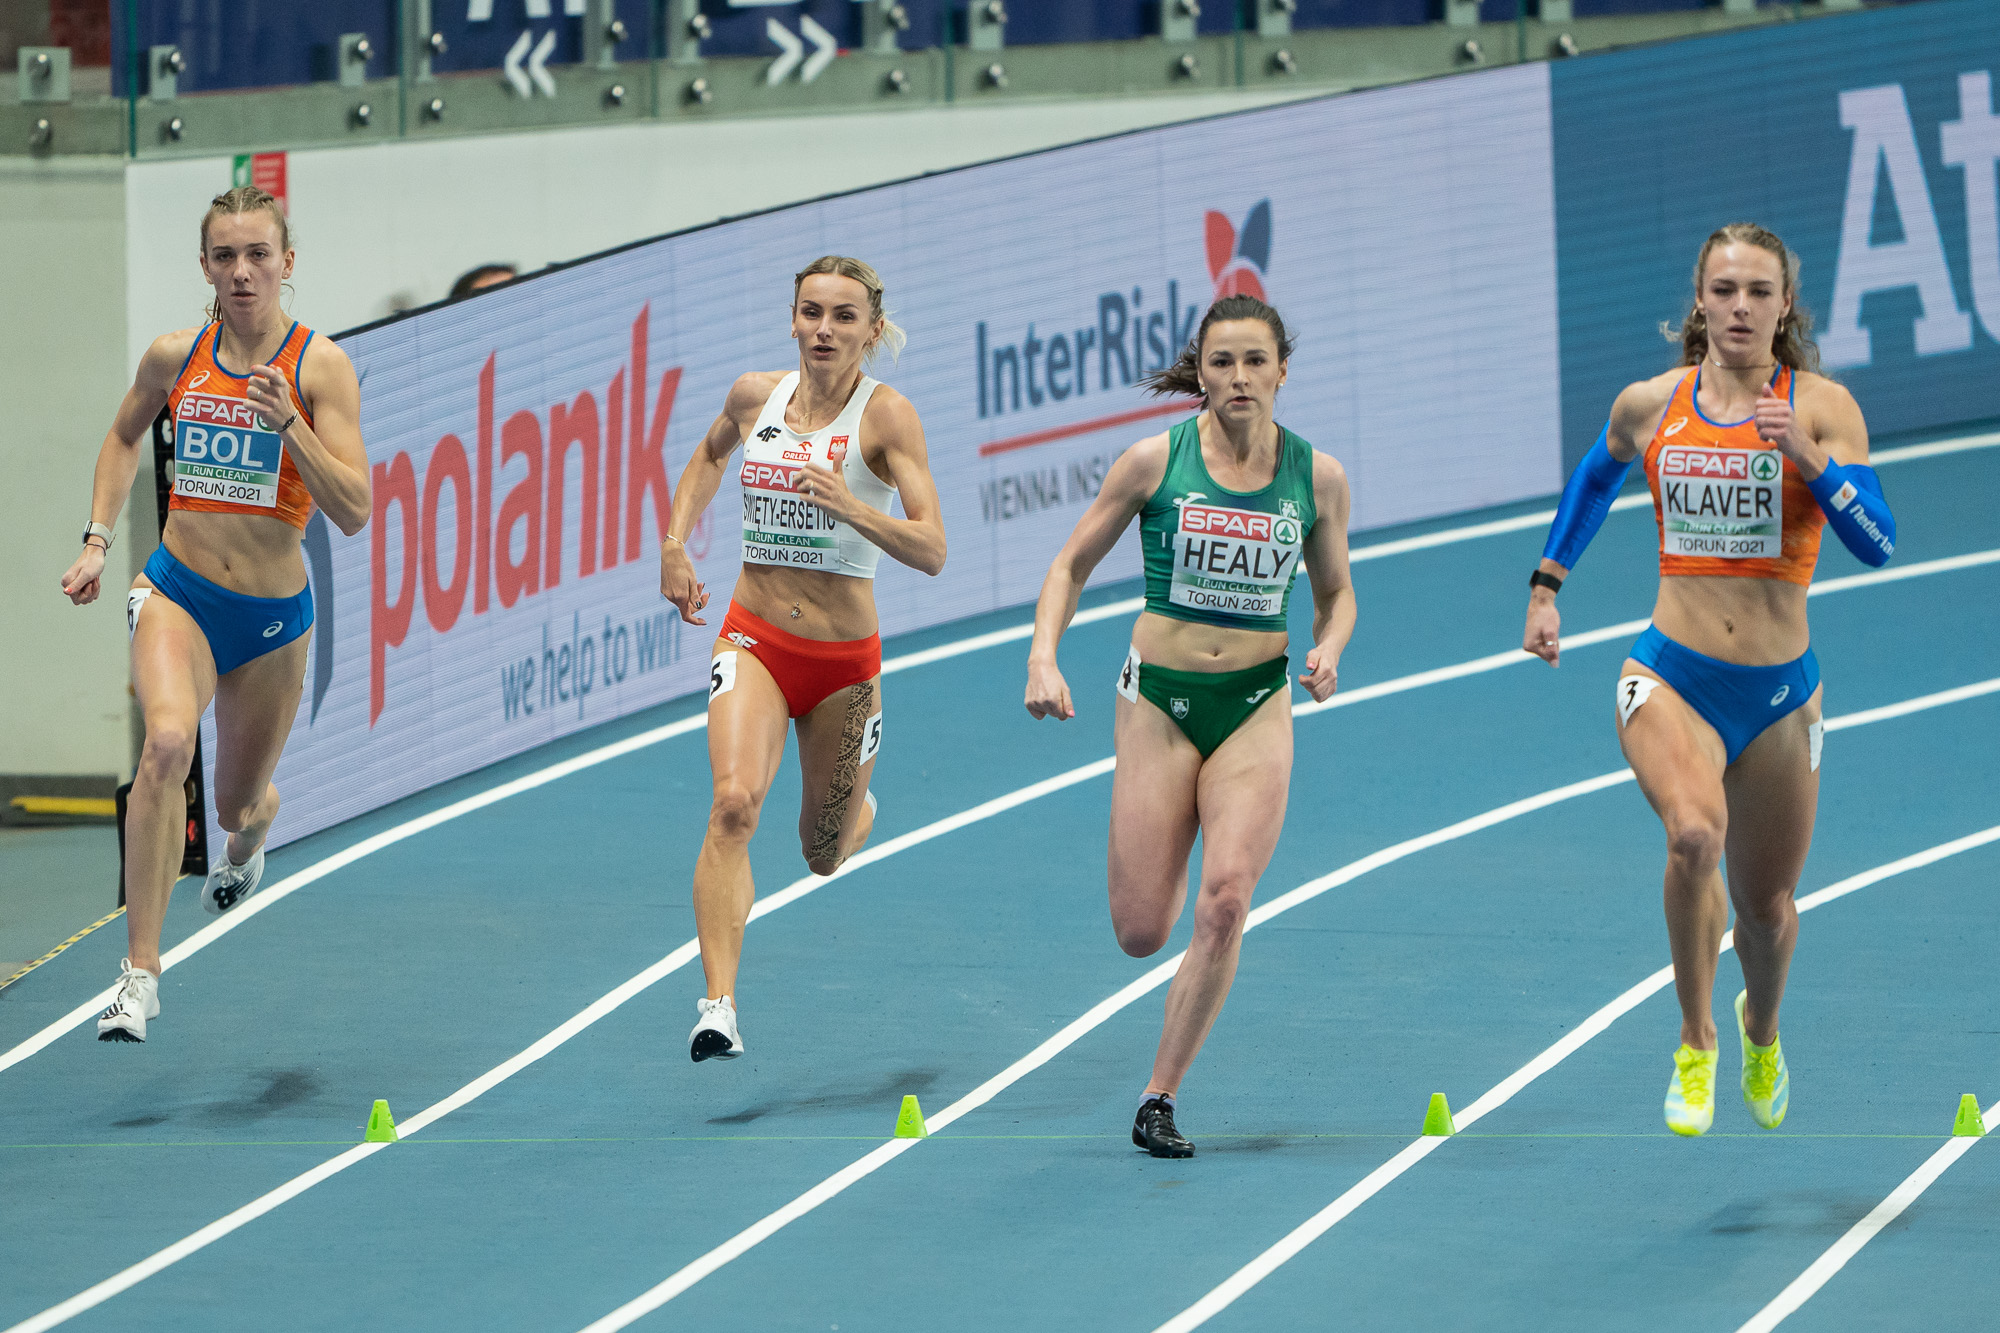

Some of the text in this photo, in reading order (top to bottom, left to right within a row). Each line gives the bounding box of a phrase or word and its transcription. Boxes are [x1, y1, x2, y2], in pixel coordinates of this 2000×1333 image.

[977, 279, 1198, 418] InterRisk
[182, 398, 251, 425] SPAR
[183, 426, 263, 467] BOL
[783, 452, 810, 461] ORLEN
[192, 467, 213, 477] RUN
[1665, 452, 1745, 477] SPAR
[178, 479, 261, 501] TORUŃ 2021
[979, 469, 1060, 523] VIENNA
[1666, 482, 1773, 518] KLAVER
[370, 298, 685, 731] polanik
[1184, 510, 1268, 538] SPAR
[755, 533, 775, 543] RUN
[1730, 540, 1764, 554] 2021
[745, 545, 823, 564] TORUŃ 2021
[1184, 537, 1292, 579] HEALY
[1202, 579, 1226, 590] RUN
[1187, 590, 1272, 612] TORUŃ 2021
[501, 608, 682, 722] we help to win
[710, 661, 723, 696] 5
[1123, 656, 1132, 690] 4
[1626, 680, 1639, 711] 3
[868, 718, 882, 754] 5
